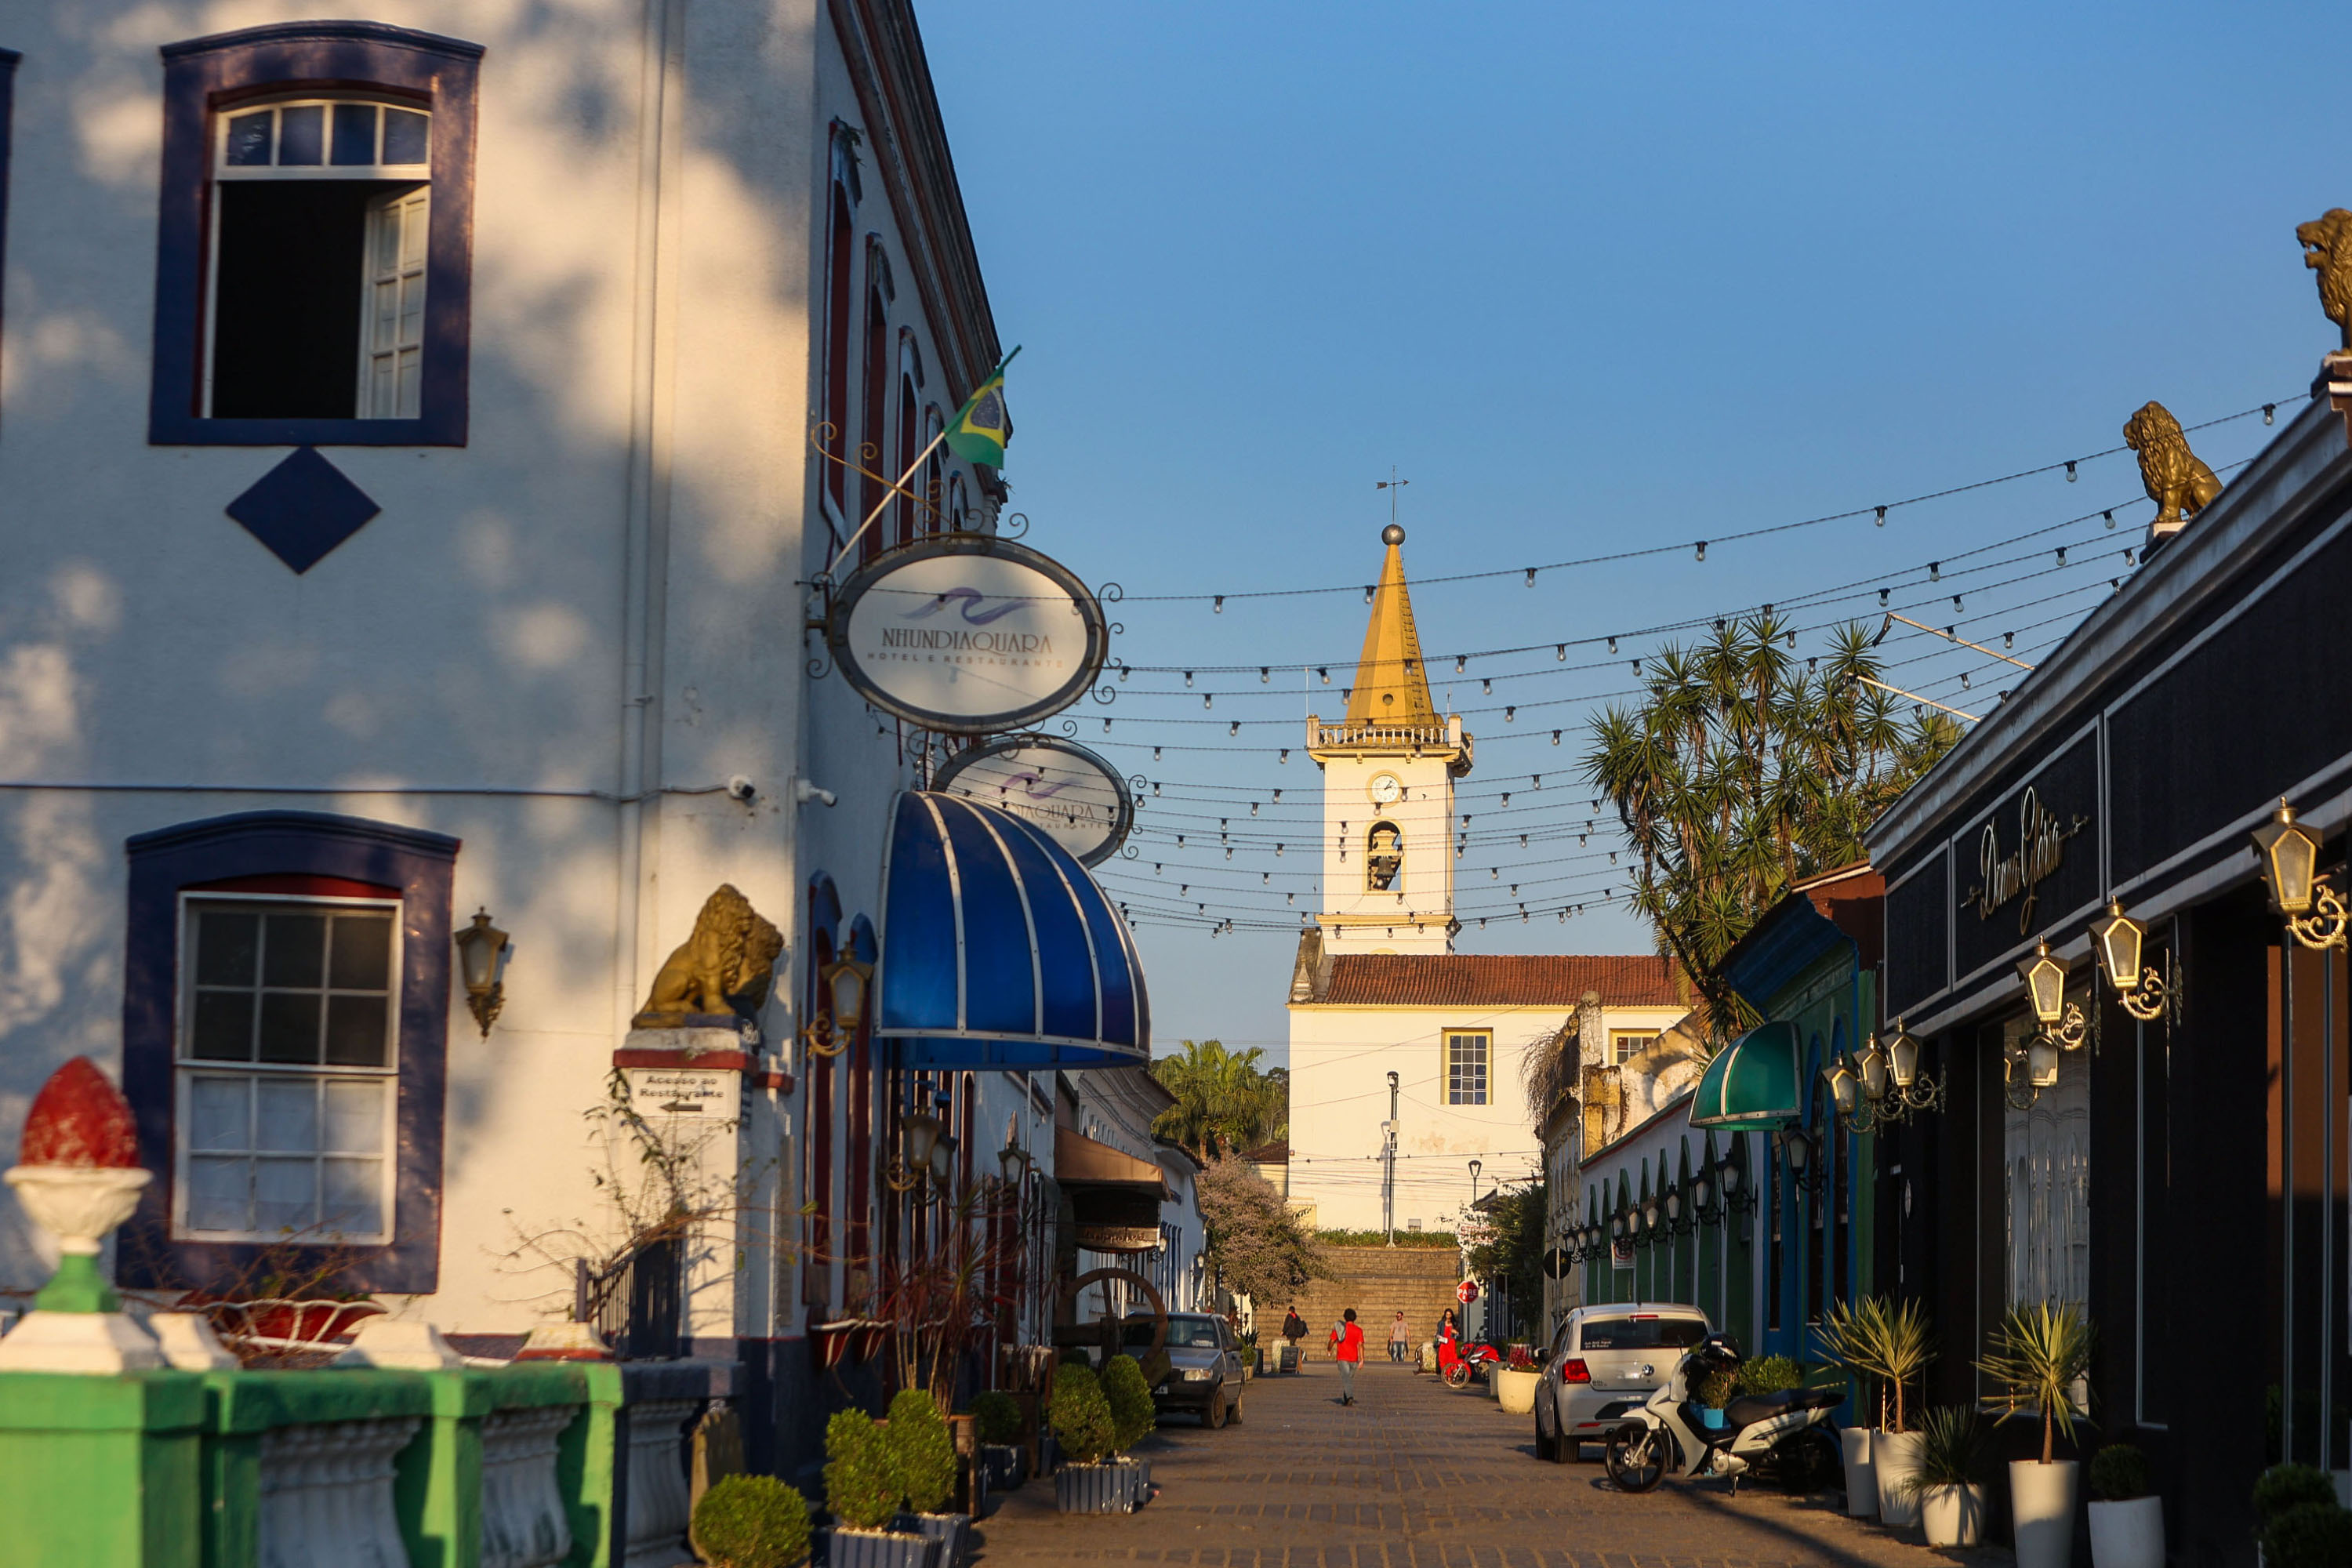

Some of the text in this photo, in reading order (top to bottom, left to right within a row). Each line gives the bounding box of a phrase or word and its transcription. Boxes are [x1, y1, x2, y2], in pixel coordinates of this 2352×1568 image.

[882, 628, 1053, 656] NHUNDIAQUARA
[867, 652, 918, 662] HOTEL
[944, 655, 1062, 669] RESTAURANTE
[1006, 804, 1094, 822] DIAQUARA
[646, 1075, 696, 1084] Acesso
